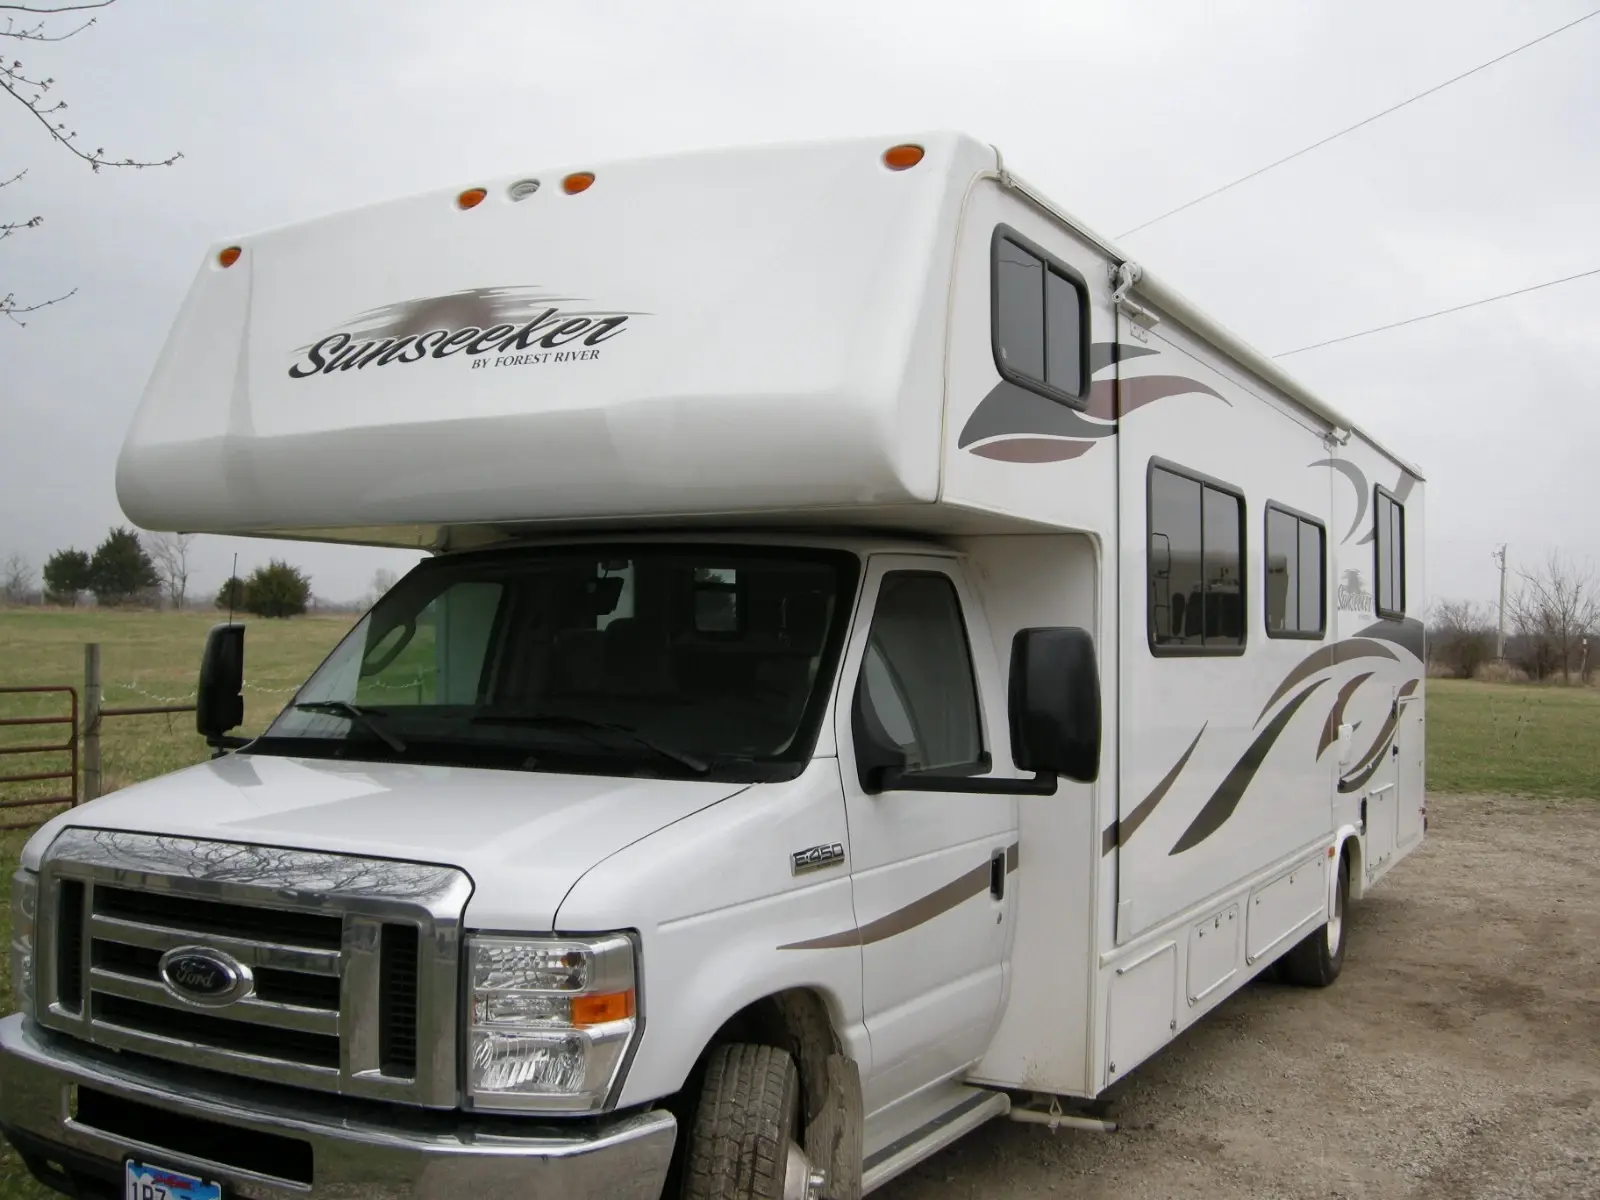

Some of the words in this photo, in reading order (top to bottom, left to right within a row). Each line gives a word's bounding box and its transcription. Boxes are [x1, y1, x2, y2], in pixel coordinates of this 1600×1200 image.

[288, 307, 629, 378] Sunseeker
[471, 358, 490, 369] BY
[494, 353, 551, 367] FOREST
[554, 349, 600, 362] RIVER
[176, 960, 216, 988] Ford
